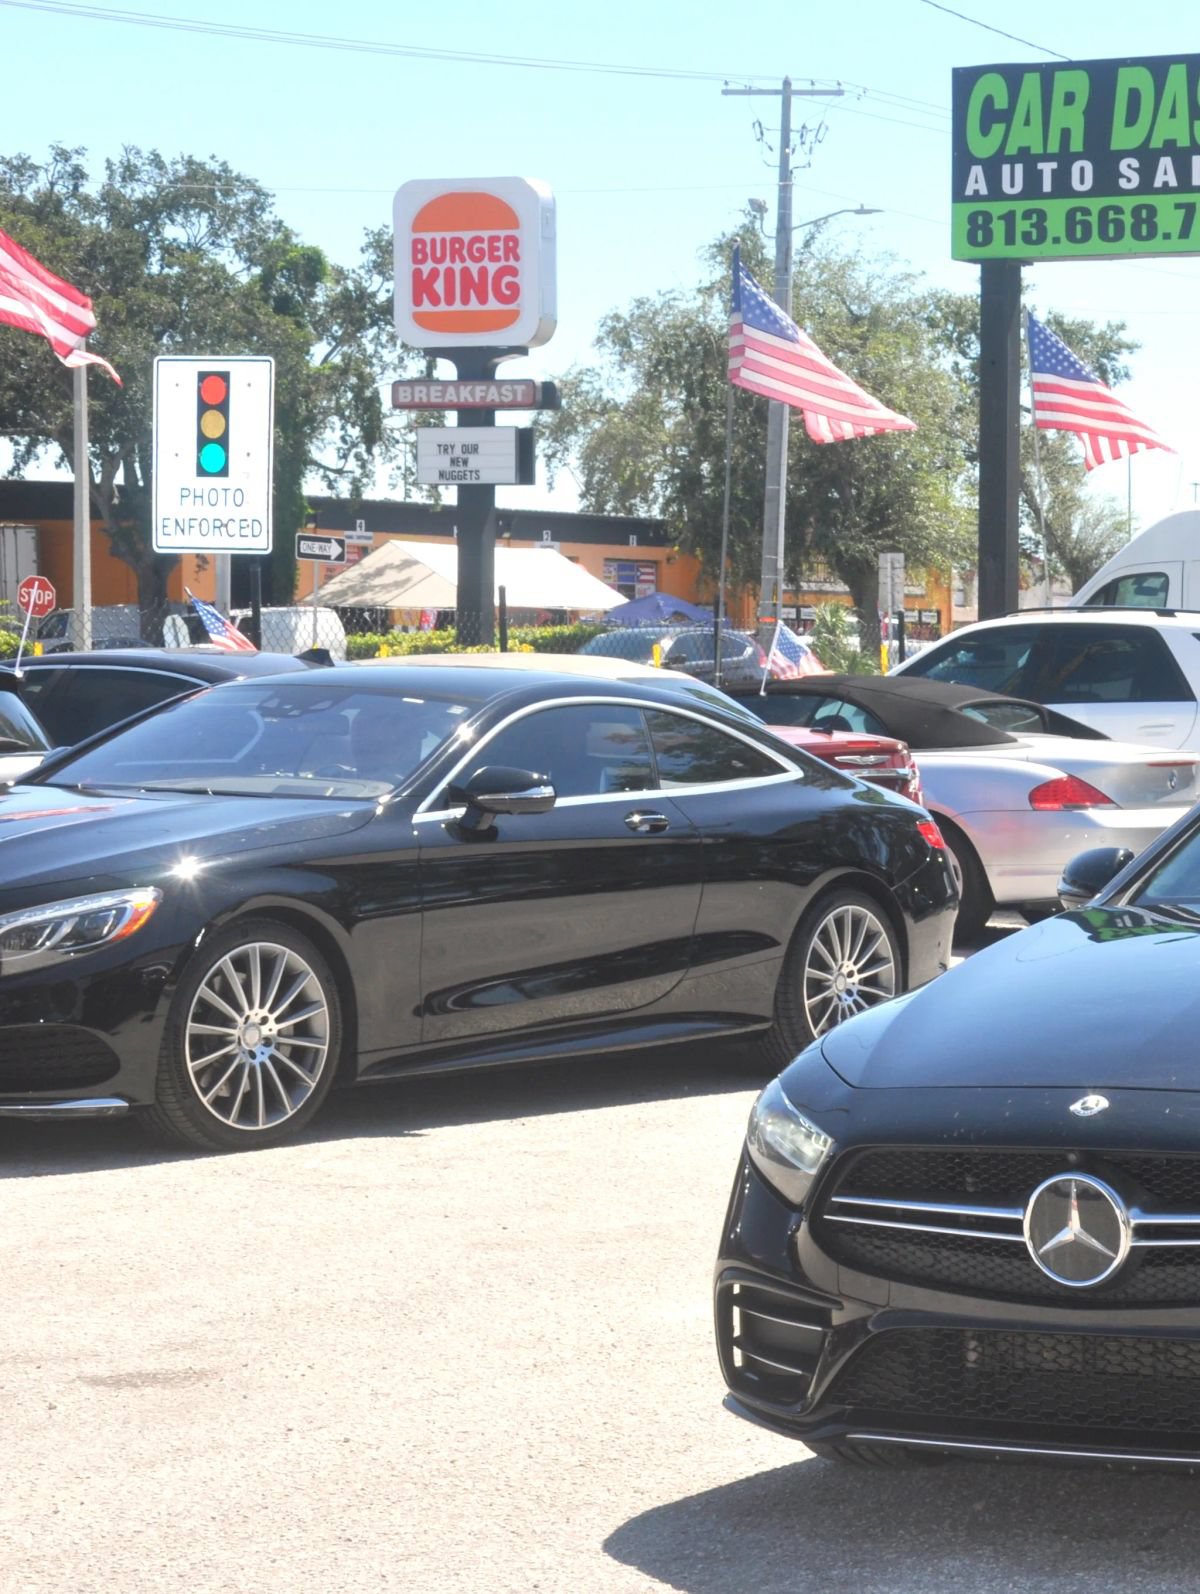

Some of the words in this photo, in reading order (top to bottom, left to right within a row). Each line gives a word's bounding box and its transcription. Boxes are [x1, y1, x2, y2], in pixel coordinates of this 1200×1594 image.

[966, 69, 1090, 159] CAR
[964, 160, 1094, 196] AUTO
[411, 235, 520, 265] BURGER
[412, 264, 520, 307] KING
[399, 384, 526, 403] BREAKFAST
[437, 444, 455, 455] TRY
[461, 444, 479, 455] OUR
[450, 457, 469, 467] NEW
[438, 470, 480, 481] NUGGETS
[180, 487, 245, 507] PHOTO
[162, 517, 263, 538] ENFORCED
[302, 542, 317, 553] ONE
[318, 543, 332, 554] WAY
